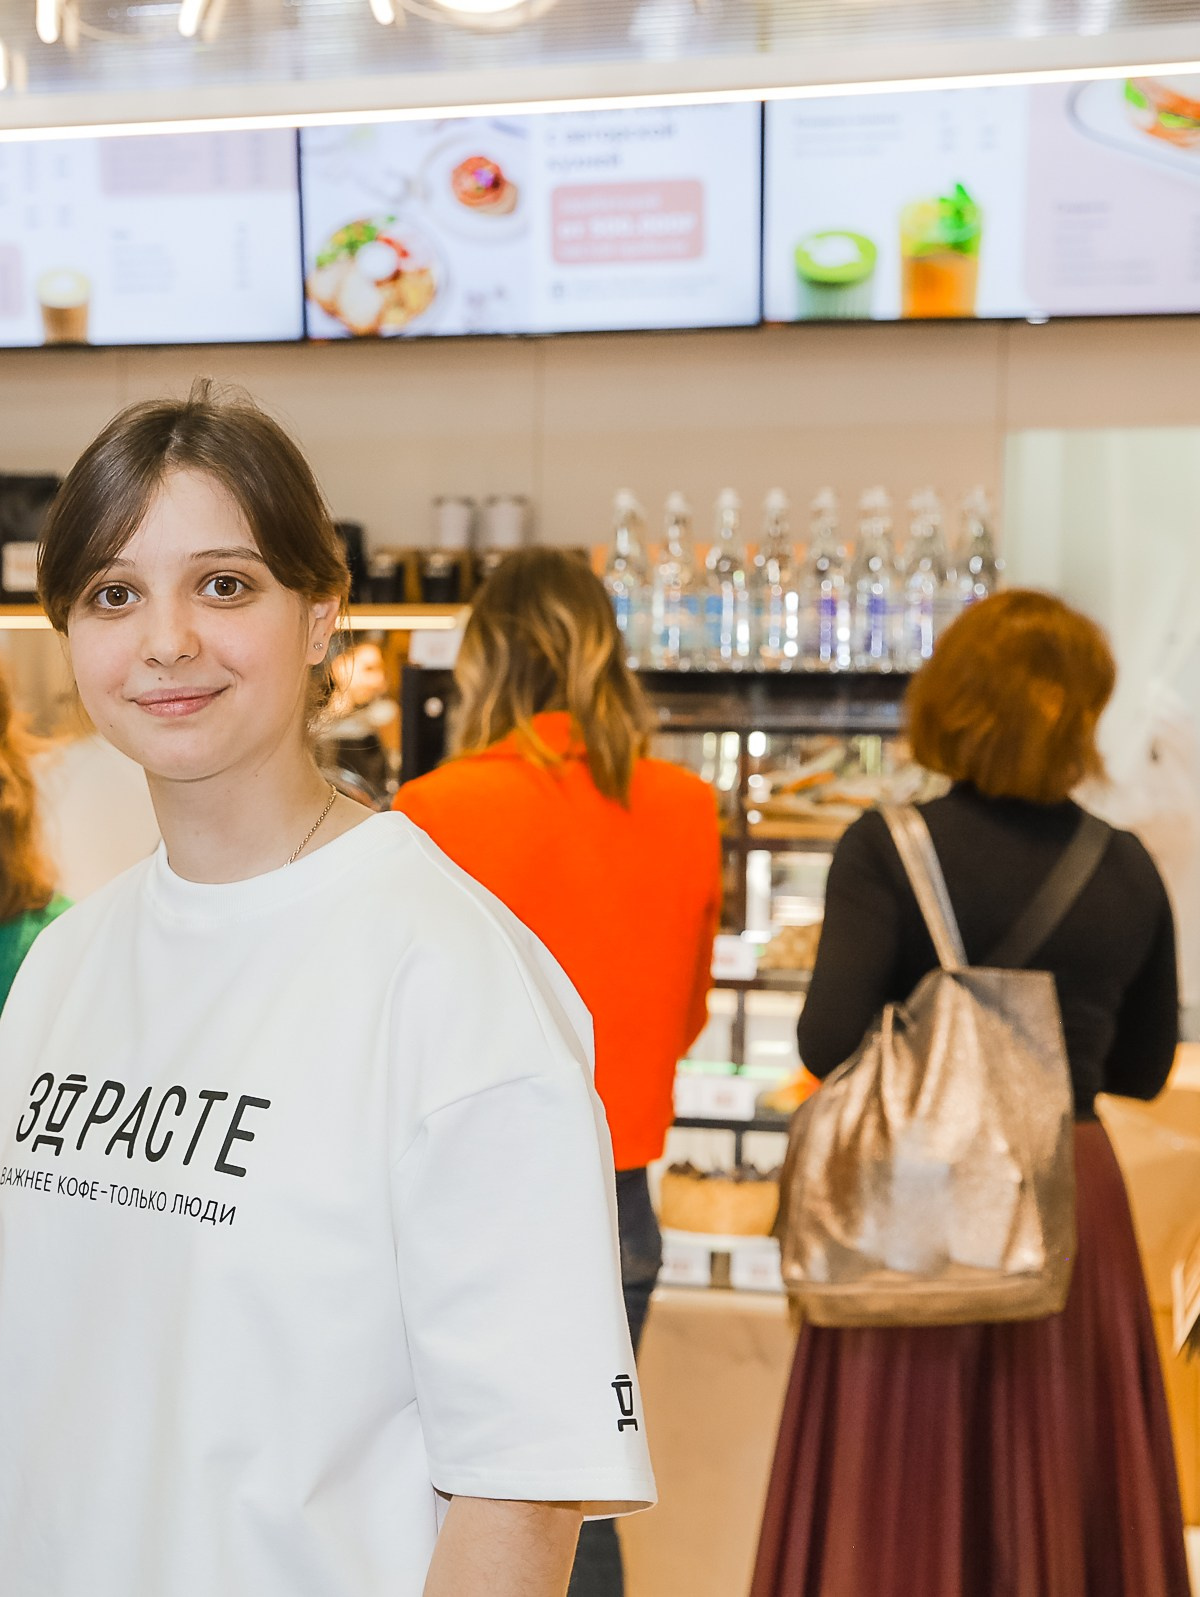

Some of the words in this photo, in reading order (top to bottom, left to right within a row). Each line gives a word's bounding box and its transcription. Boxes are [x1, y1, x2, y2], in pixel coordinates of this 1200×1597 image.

[15, 1072, 271, 1178] ЗДРАСТЕ
[0, 1166, 54, 1192] ВАЖНЕЕ
[171, 1193, 237, 1226] ЛЮДИ
